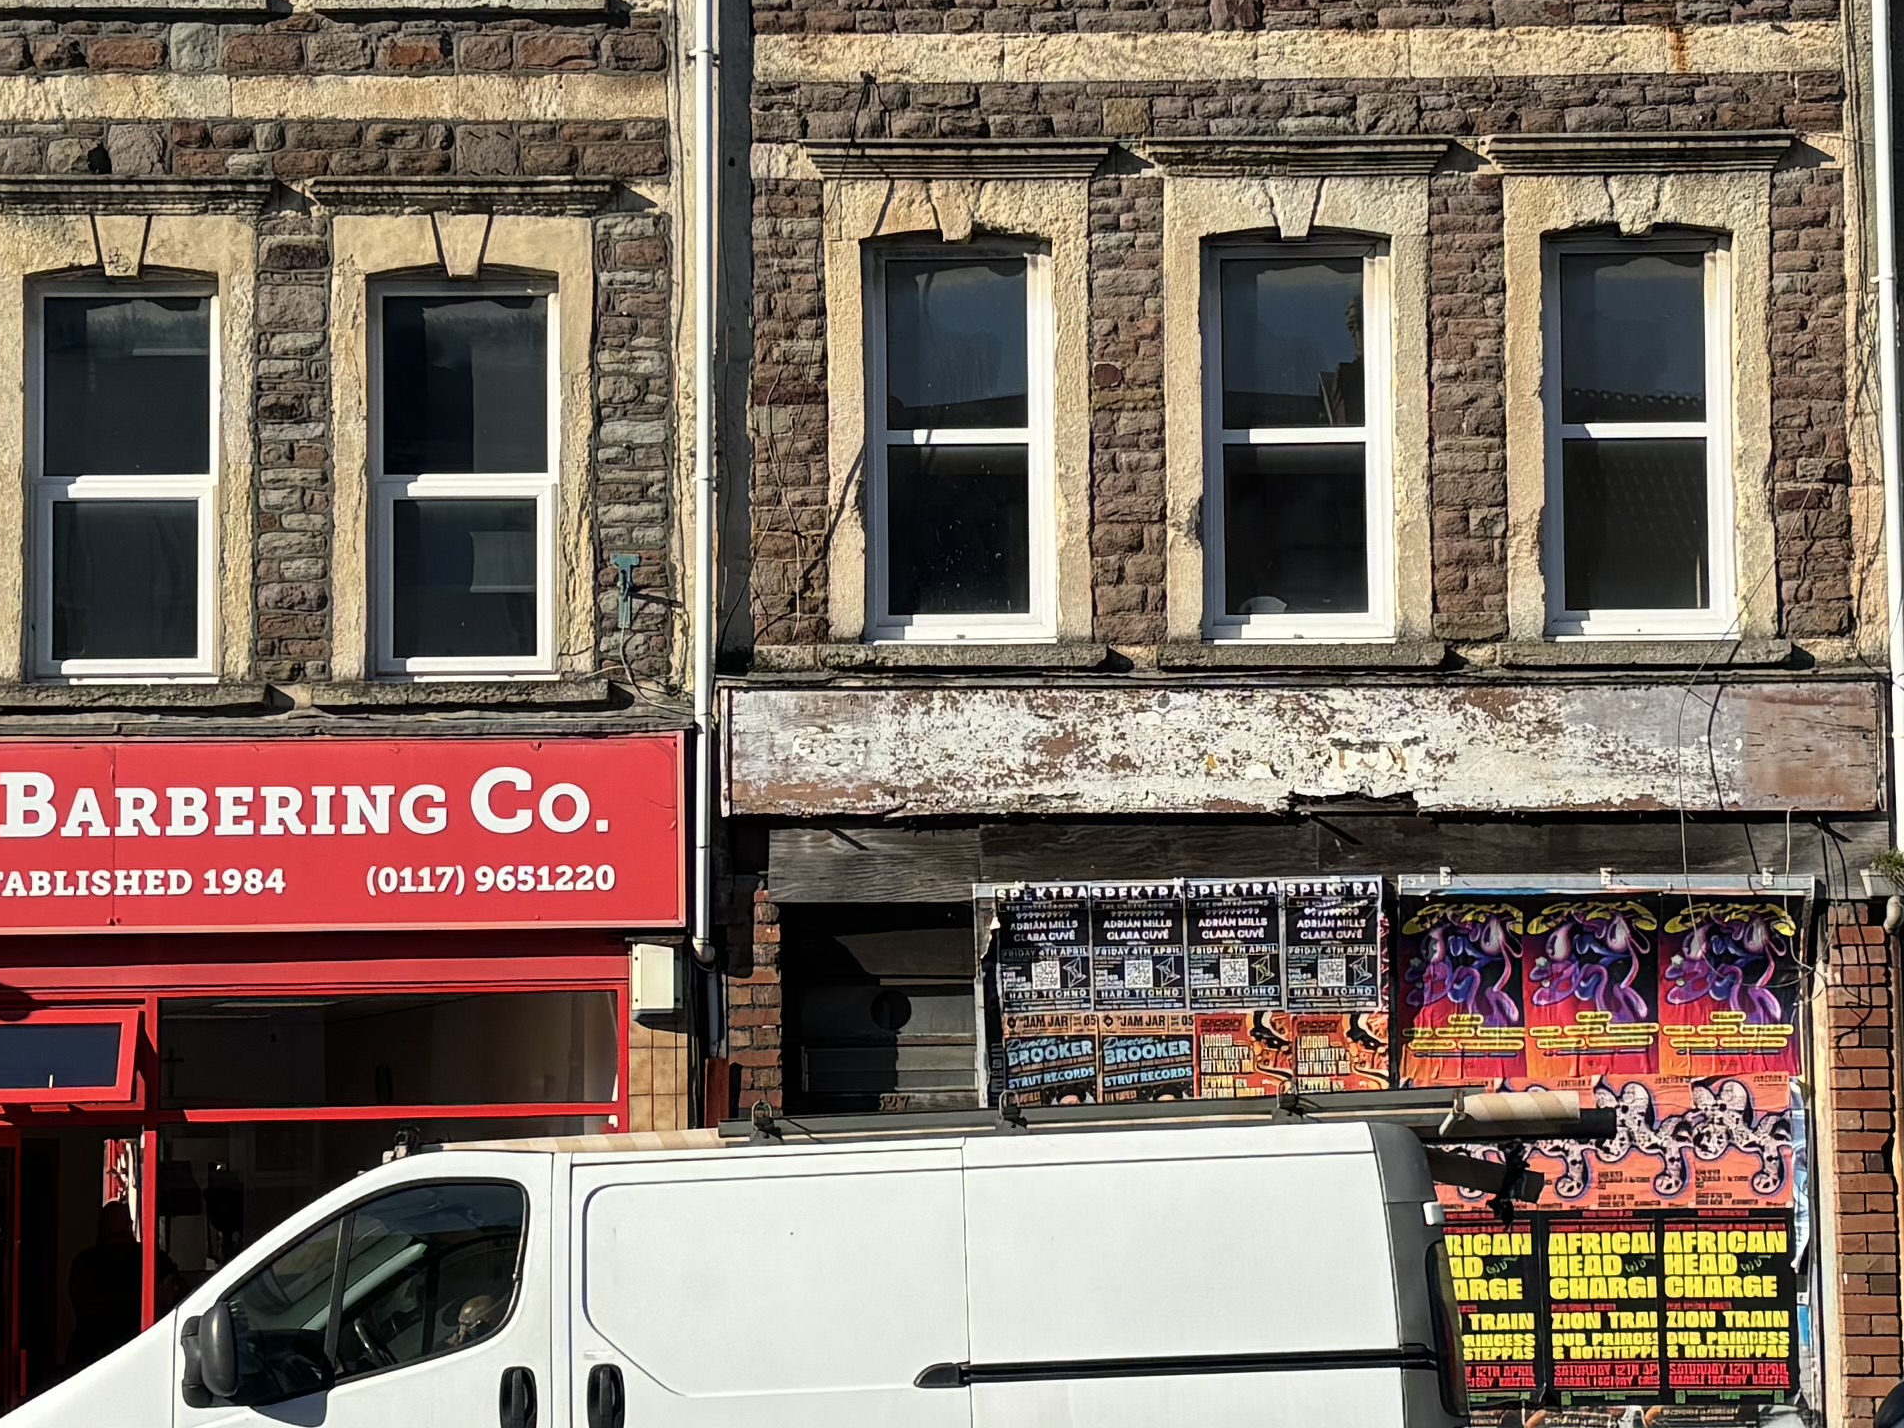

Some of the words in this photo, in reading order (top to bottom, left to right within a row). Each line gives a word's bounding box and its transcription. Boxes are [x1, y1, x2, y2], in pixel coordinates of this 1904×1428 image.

[203, 867, 286, 896] 1984
[366, 864, 466, 898] (0117)
[475, 864, 616, 893] 9651220
[1187, 882, 1278, 898] SPEKTRA
[1238, 917, 1267, 926] MILLS
[1024, 1015, 1045, 1028] JAM
[1048, 1015, 1068, 1027] JAR
[1120, 1015, 1143, 1027] JAM
[1145, 1014, 1166, 1026] JAR
[1181, 1014, 1194, 1026] 05
[1007, 1040, 1094, 1066] BROOKER
[1104, 1040, 1191, 1065] BROOKER
[1104, 1073, 1139, 1087] STRUT
[1140, 1066, 1193, 1082] RECORDS
[1445, 1233, 1532, 1256] RICAN
[1663, 1230, 1788, 1254] AFRICAN
[1548, 1255, 1623, 1278] HEAD
[1663, 1254, 1738, 1276] HEAD
[1664, 1275, 1778, 1298] CHARGE
[1468, 1313, 1535, 1330] TRAIN
[1551, 1312, 1602, 1330] ZION
[1666, 1311, 1716, 1328] ZION
[1722, 1310, 1789, 1328] TRAIN
[1462, 1333, 1536, 1347] RINCESS
[1552, 1332, 1586, 1346] DUB
[1666, 1332, 1701, 1345] DUB
[1706, 1331, 1790, 1345] PRINCESS
[1463, 1347, 1536, 1361] STEPPAS
[1553, 1346, 1564, 1359] &
[1666, 1345, 1679, 1358] &
[1684, 1345, 1790, 1358] HOTSTEPPAS
[1554, 1364, 1612, 1377] SATURDAY
[1615, 1364, 1640, 1376] 12TH
[1669, 1363, 1726, 1375] SATURDAY
[1729, 1362, 1754, 1375] 12TH
